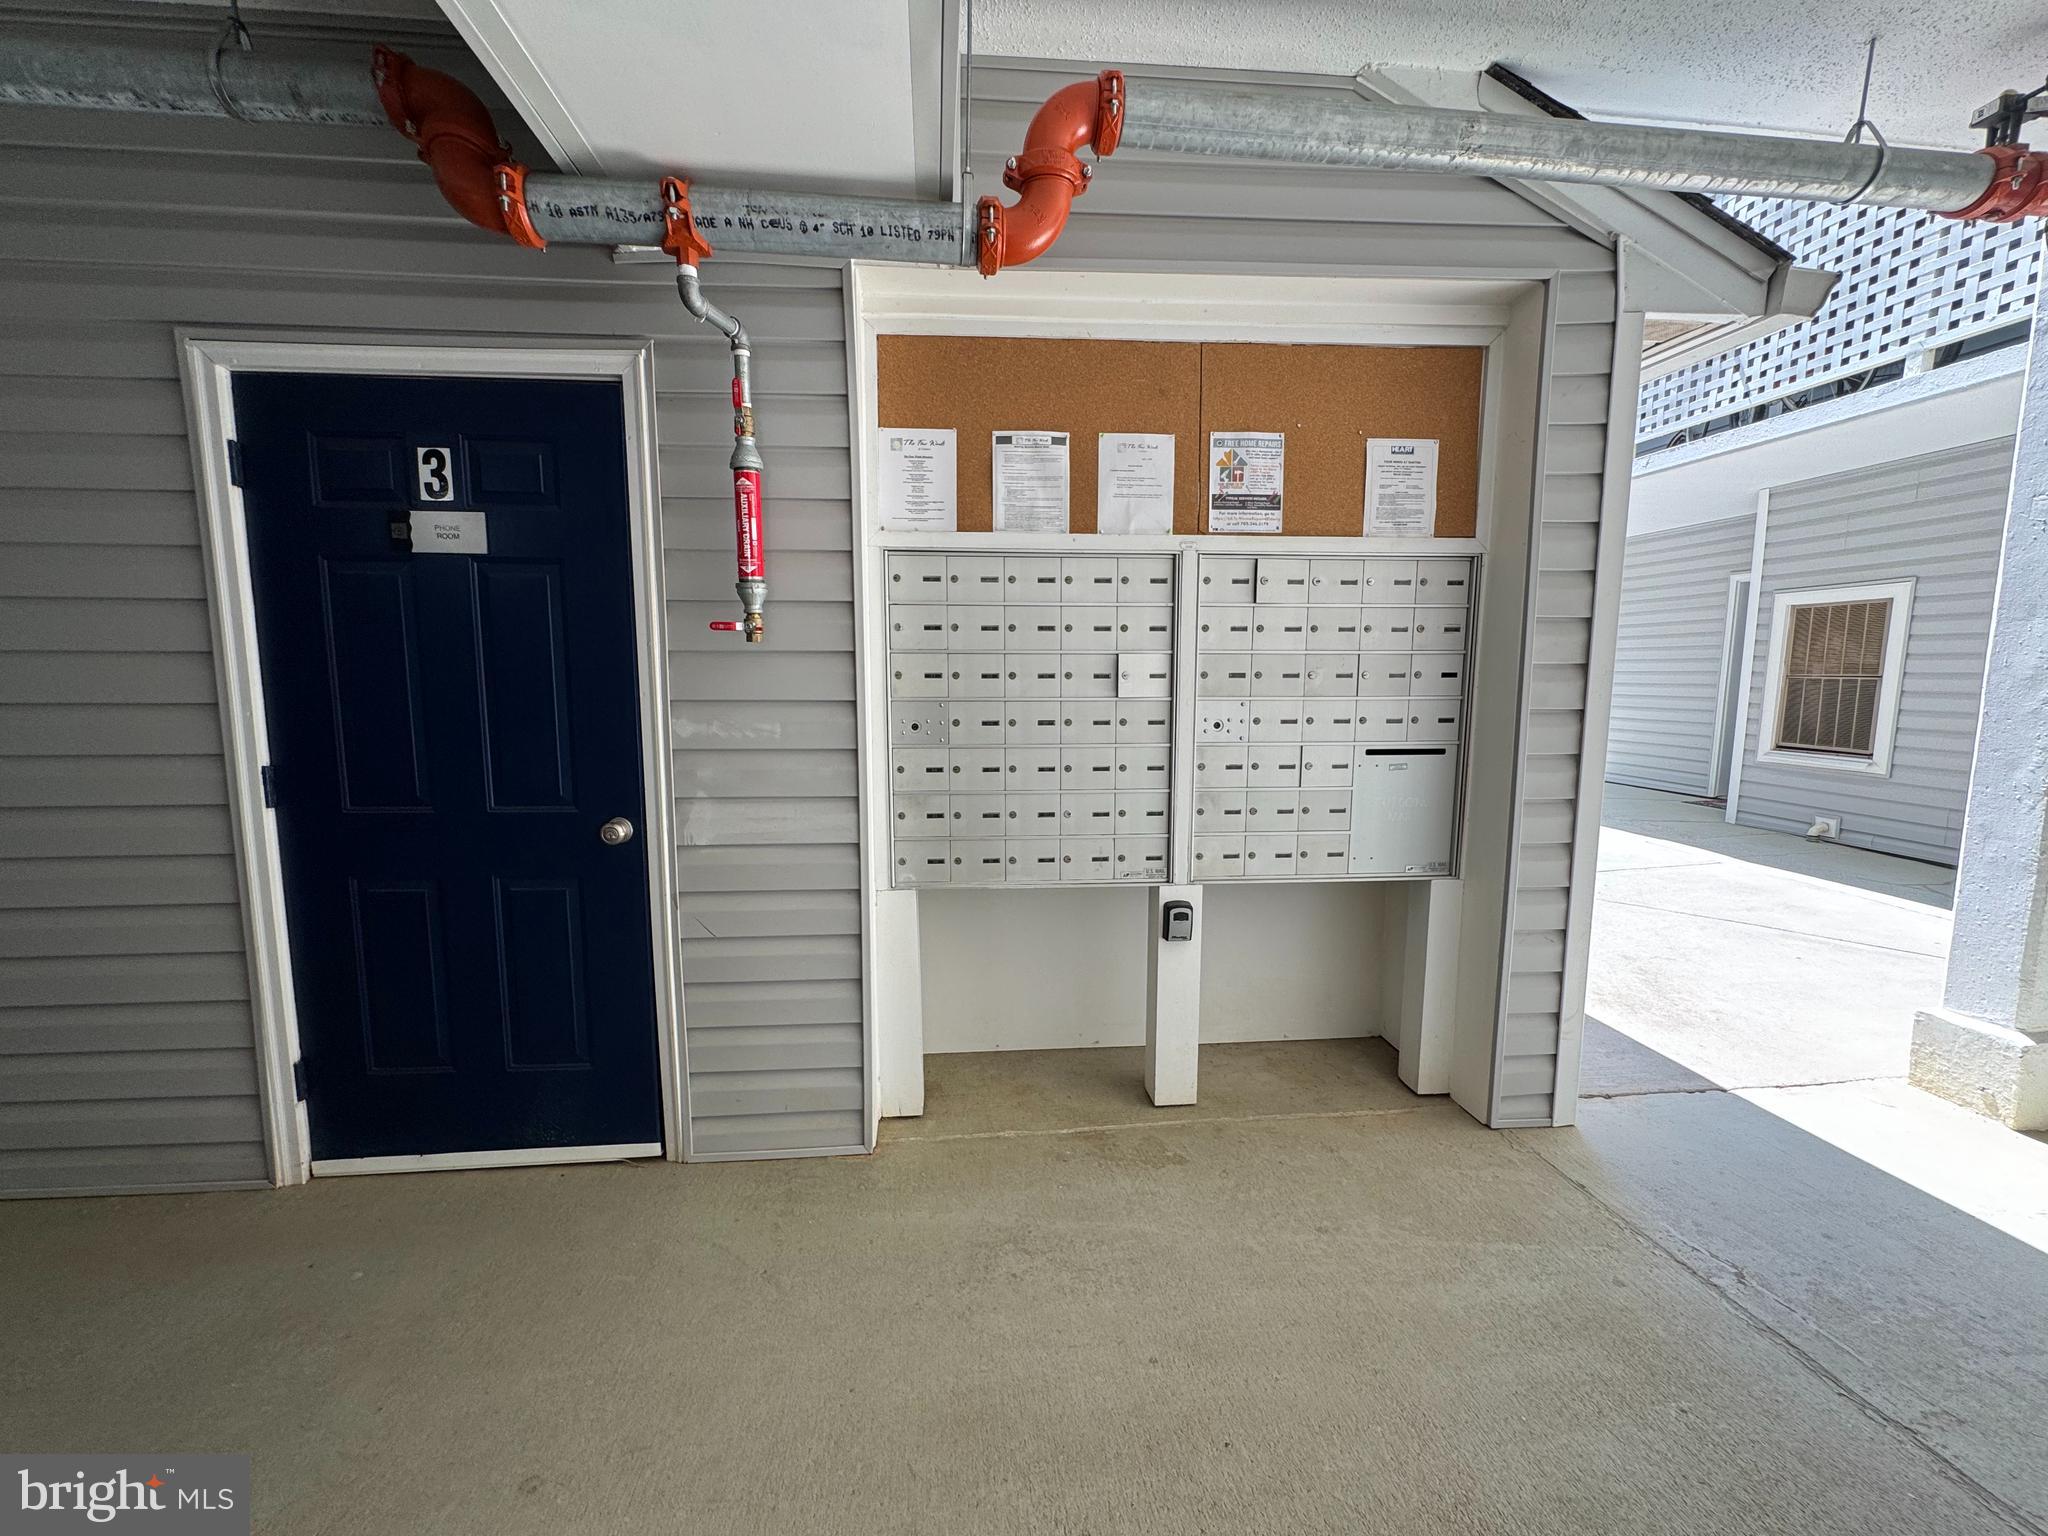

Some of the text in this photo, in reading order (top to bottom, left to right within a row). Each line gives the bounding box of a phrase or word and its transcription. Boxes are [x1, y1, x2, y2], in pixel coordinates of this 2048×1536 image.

[568, 204, 598, 218] ASTM
[605, 205, 664, 224] A135/A79
[880, 224, 921, 242] LISTED
[1224, 439, 1282, 449] FREE HOME REPAIRS
[421, 448, 449, 500] 3
[740, 493, 750, 531] AUXILIARY
[434, 524, 461, 532] PHONE
[436, 532, 460, 540] ROOM
